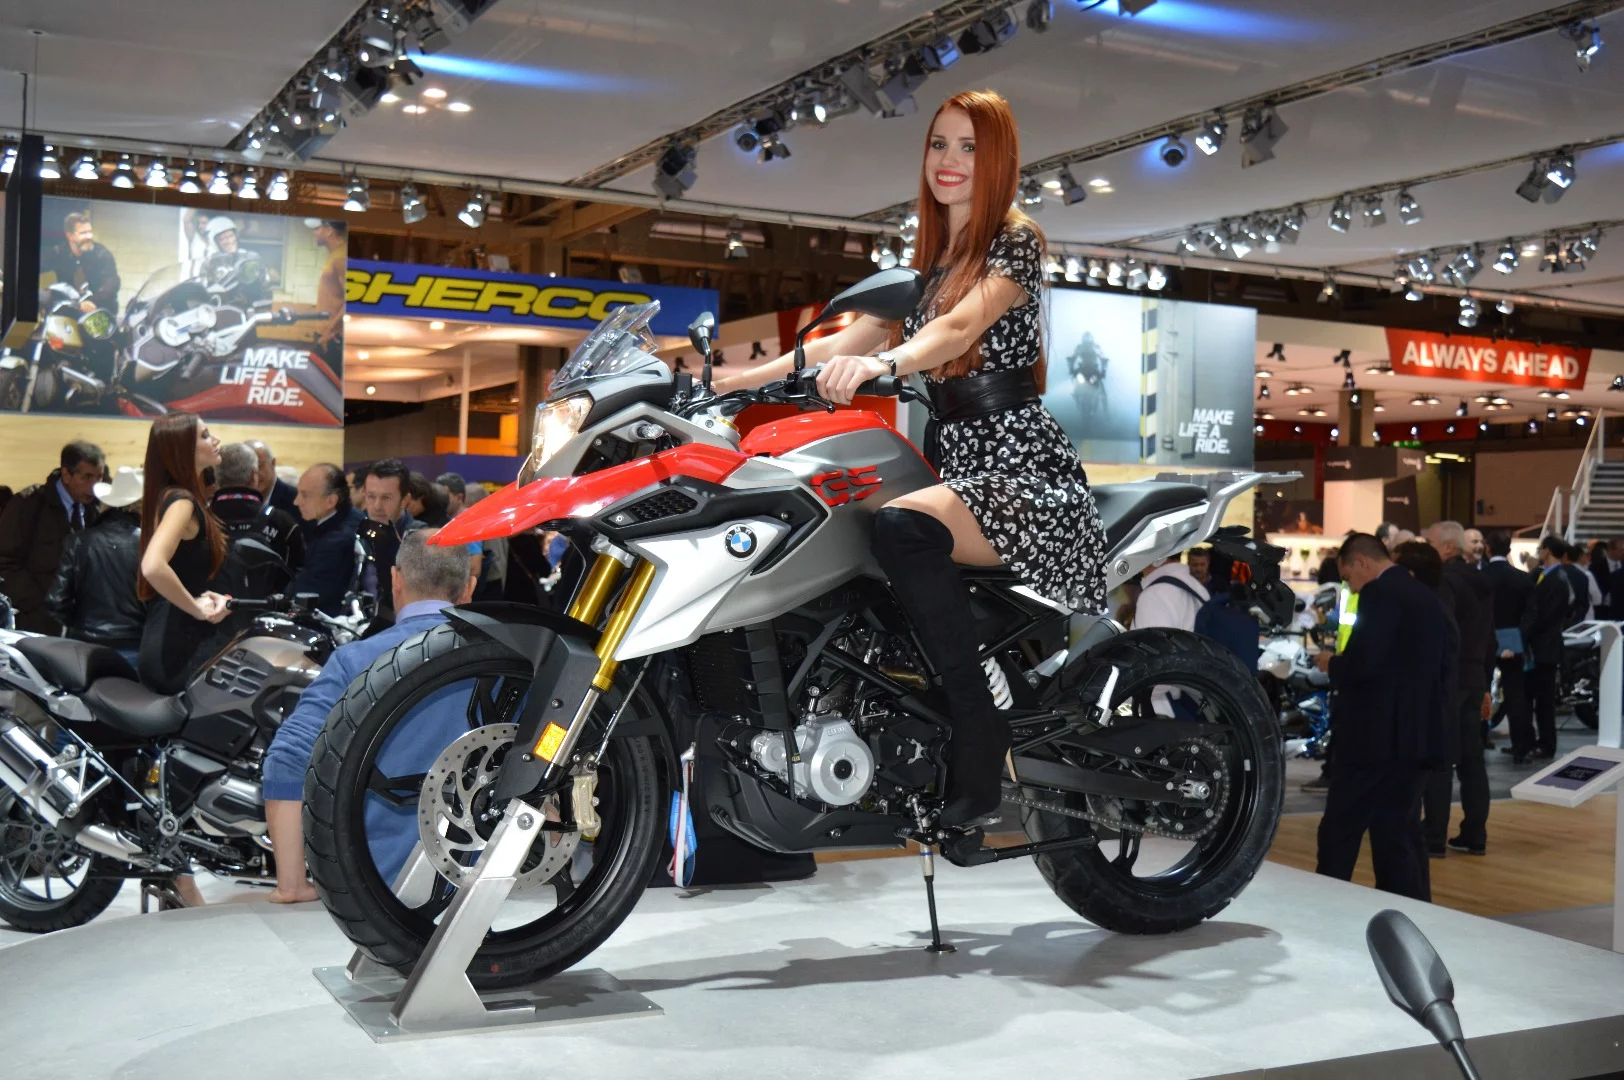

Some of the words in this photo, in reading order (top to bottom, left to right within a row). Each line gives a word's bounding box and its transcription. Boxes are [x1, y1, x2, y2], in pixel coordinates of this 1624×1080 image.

[346, 269, 652, 321] SHERCO
[243, 347, 311, 369] MAKE
[1402, 341, 1498, 373] ALWAYS
[1502, 352, 1580, 380] AHEAD
[219, 365, 270, 386] LIFE
[270, 369, 288, 387] A
[247, 386, 304, 406] RIDE.
[1193, 408, 1235, 425] MAKE
[1179, 422, 1209, 438] LIFE
[1209, 424, 1221, 438] A
[1195, 438, 1231, 454] RIDE.
[809, 464, 883, 507] GS
